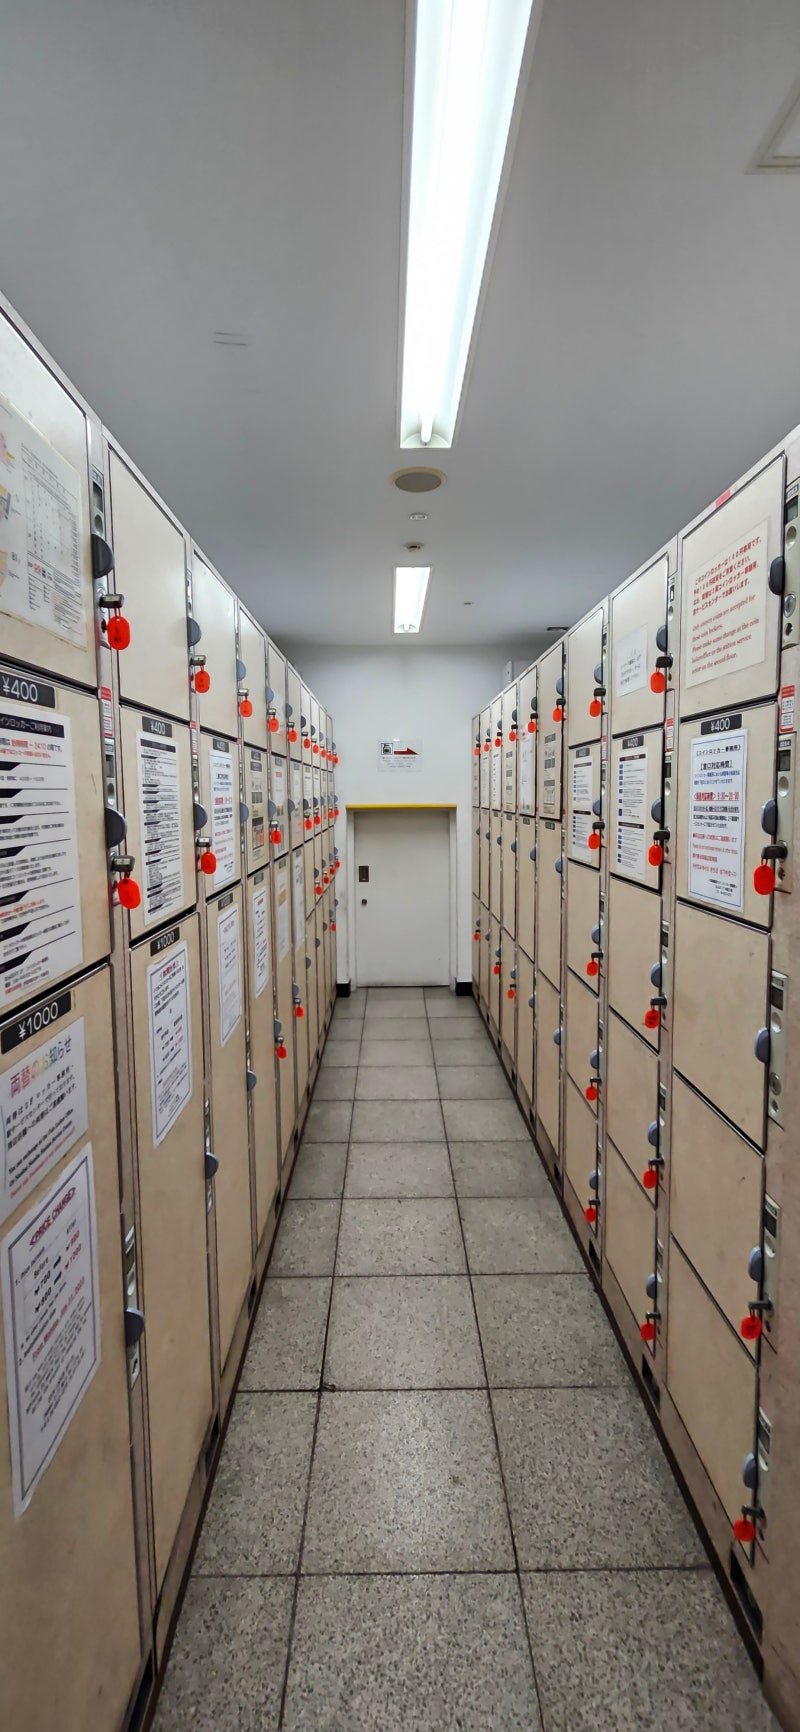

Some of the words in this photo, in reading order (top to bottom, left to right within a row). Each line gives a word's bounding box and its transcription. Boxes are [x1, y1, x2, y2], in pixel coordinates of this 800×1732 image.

[2, 674, 38, 702] ¥400
[150, 719, 166, 735] ¥400
[710, 718, 730, 732] ¥400
[157, 931, 175, 951] ¥1000
[18, 1001, 58, 1039] ¥1000
[10, 1034, 72, 1098] 両替のお知らせ
[33, 1256, 49, 1279] Before
[33, 1269, 51, 1296] ¥700
